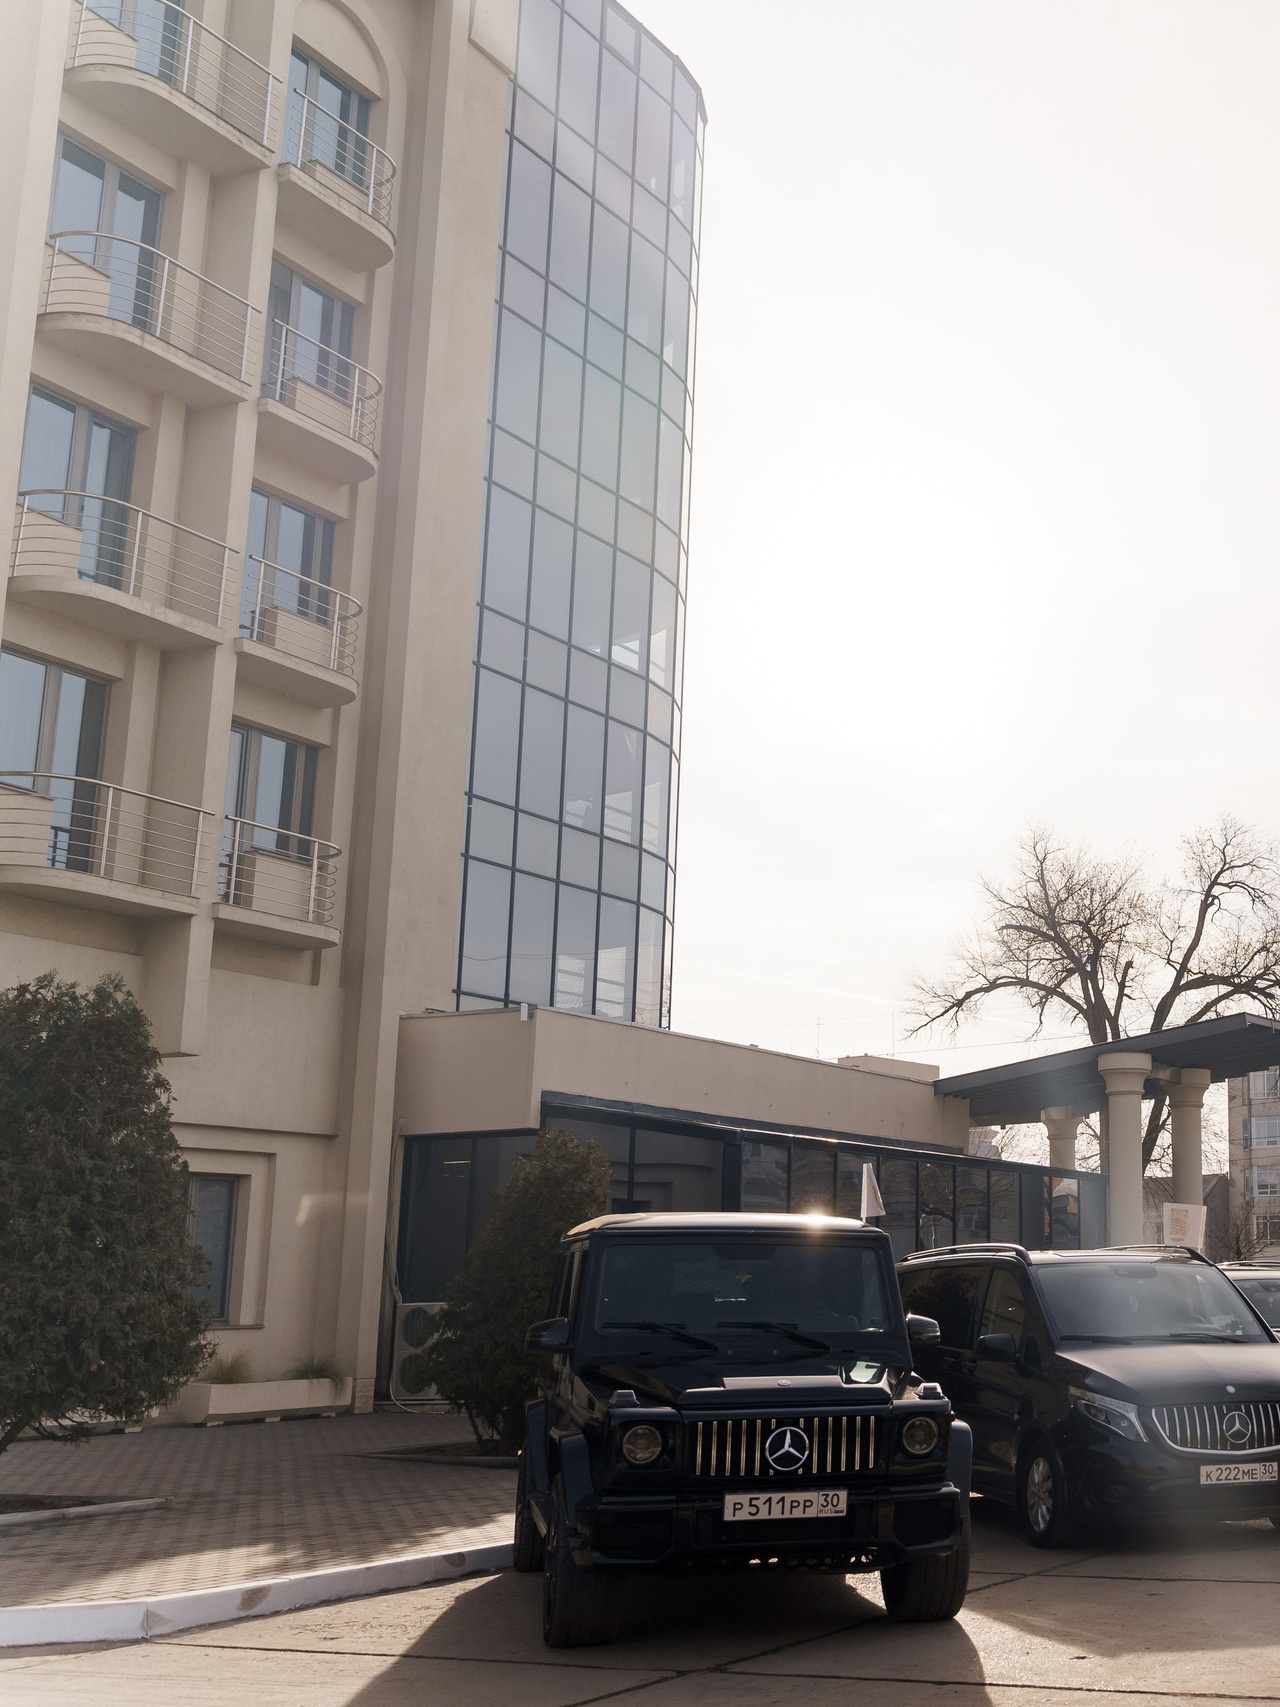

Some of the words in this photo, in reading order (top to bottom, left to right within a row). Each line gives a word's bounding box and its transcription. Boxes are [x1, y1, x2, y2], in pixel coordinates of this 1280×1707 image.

[1206, 1467, 1257, 1482] К222МЕ
[1262, 1464, 1274, 1475] 30
[733, 1496, 814, 1518] Р511РР
[820, 1493, 840, 1508] 30
